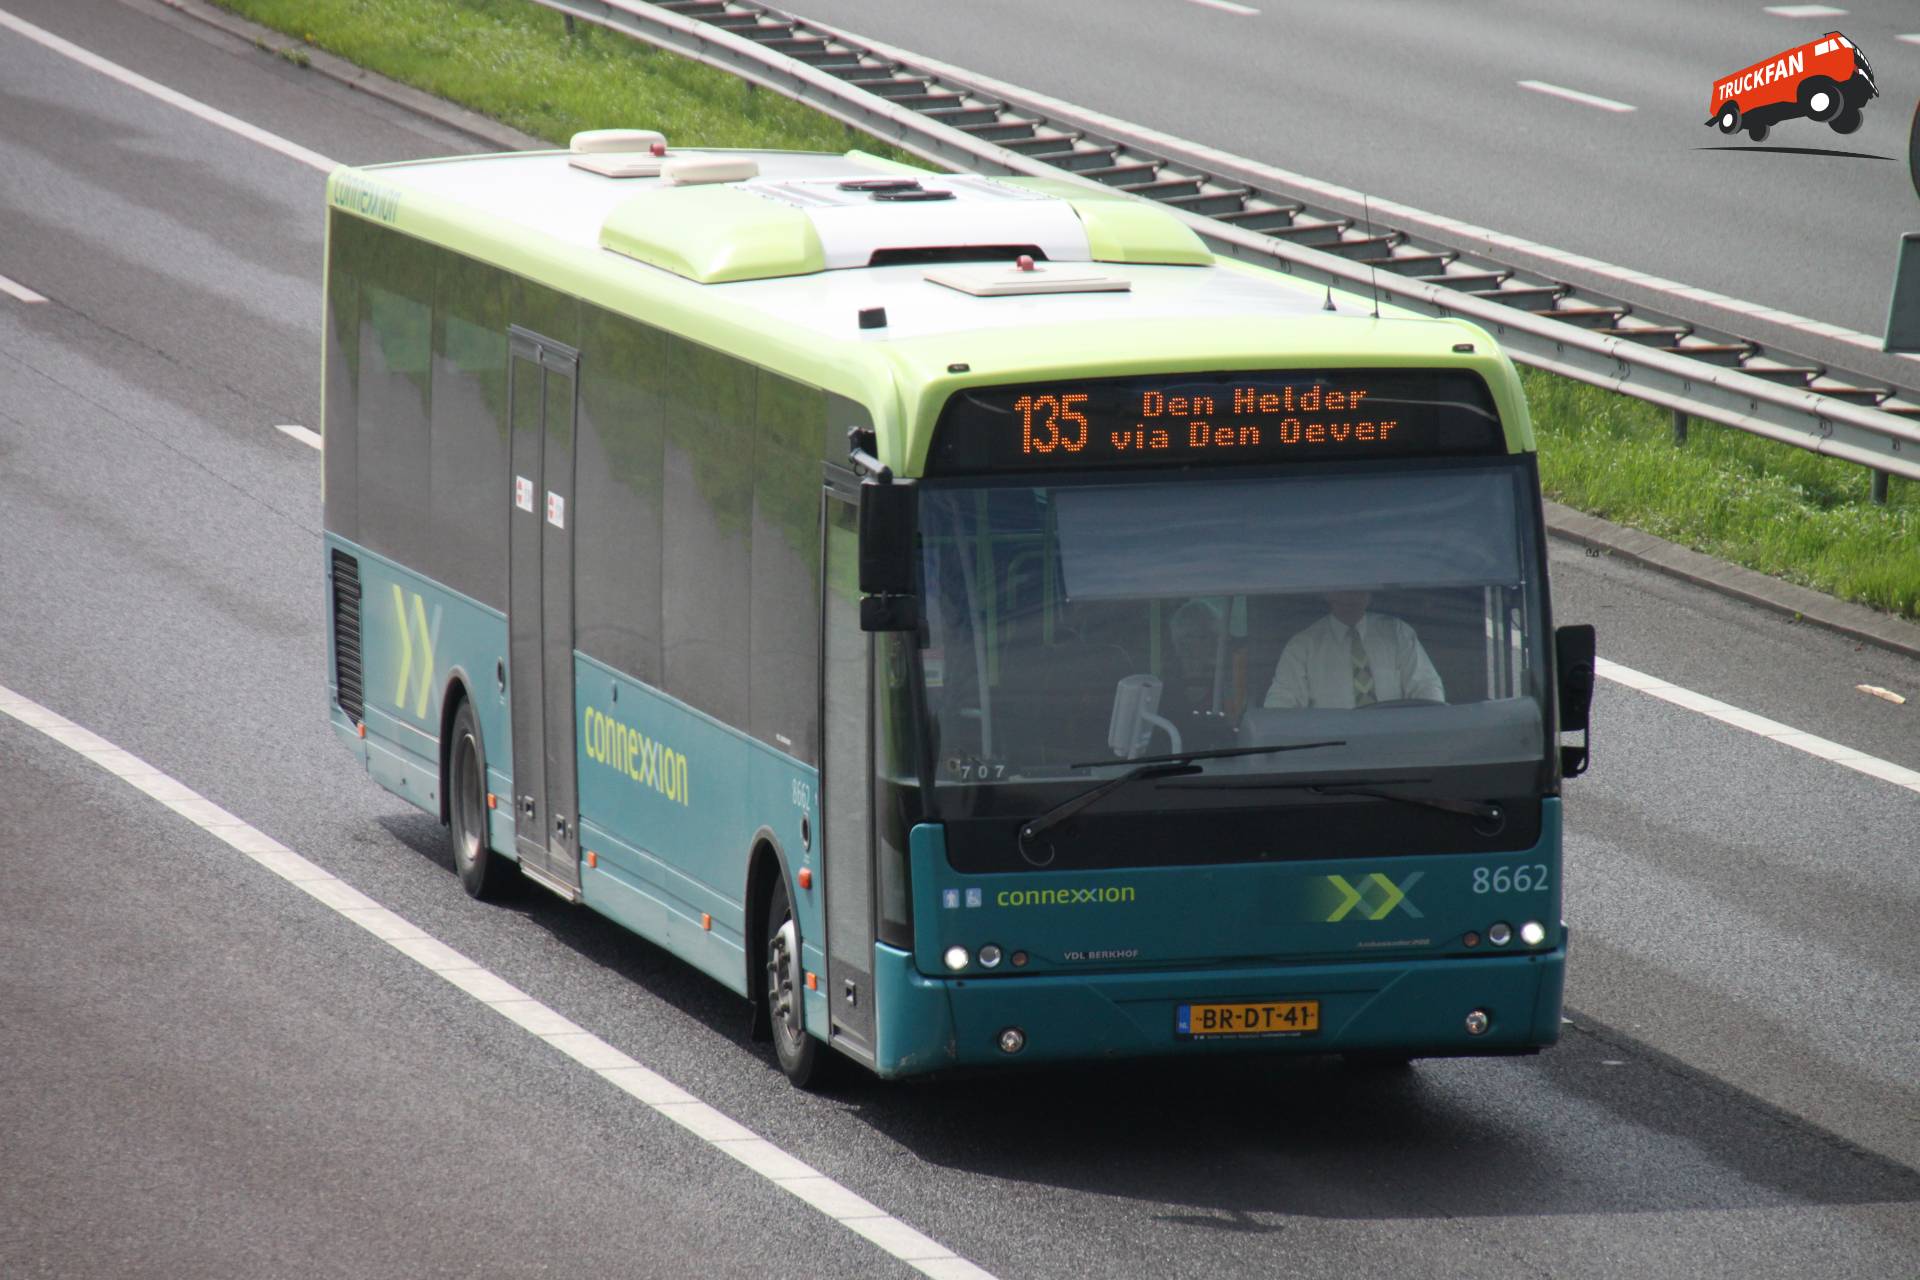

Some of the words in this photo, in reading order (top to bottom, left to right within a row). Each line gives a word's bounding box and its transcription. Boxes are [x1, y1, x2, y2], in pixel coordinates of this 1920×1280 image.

[1142, 390, 1214, 418] Den
[1234, 384, 1368, 415] Helder
[1014, 393, 1088, 454] 135
[1111, 423, 1170, 451] via
[1189, 419, 1261, 448] Den
[1280, 417, 1400, 445] Oever
[584, 705, 688, 806] connexxion
[1472, 864, 1549, 894] 8662
[996, 885, 1136, 908] connexxion
[1063, 950, 1086, 961] VDL
[1088, 948, 1139, 960] BERKHOF
[1202, 1005, 1309, 1030] BR-DT-41
